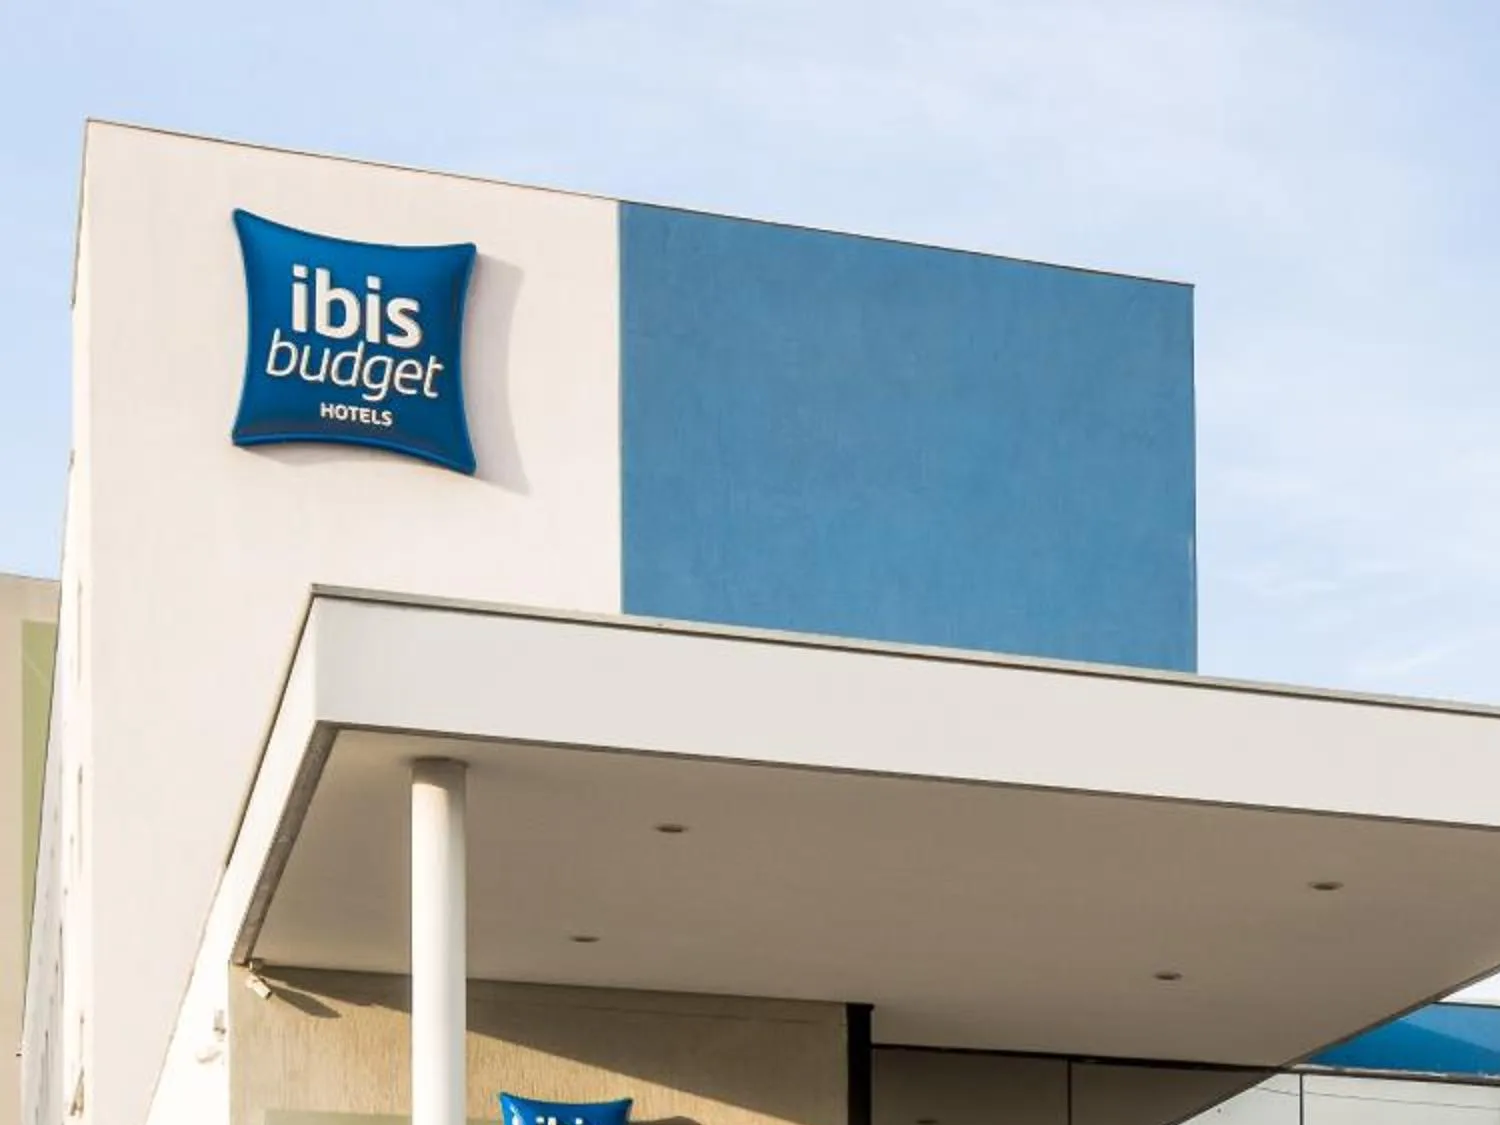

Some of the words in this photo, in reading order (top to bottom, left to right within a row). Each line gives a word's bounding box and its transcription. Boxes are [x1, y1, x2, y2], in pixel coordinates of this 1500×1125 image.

[292, 264, 422, 349] ibis
[265, 328, 444, 401] budget
[320, 402, 393, 427] HOTELS
